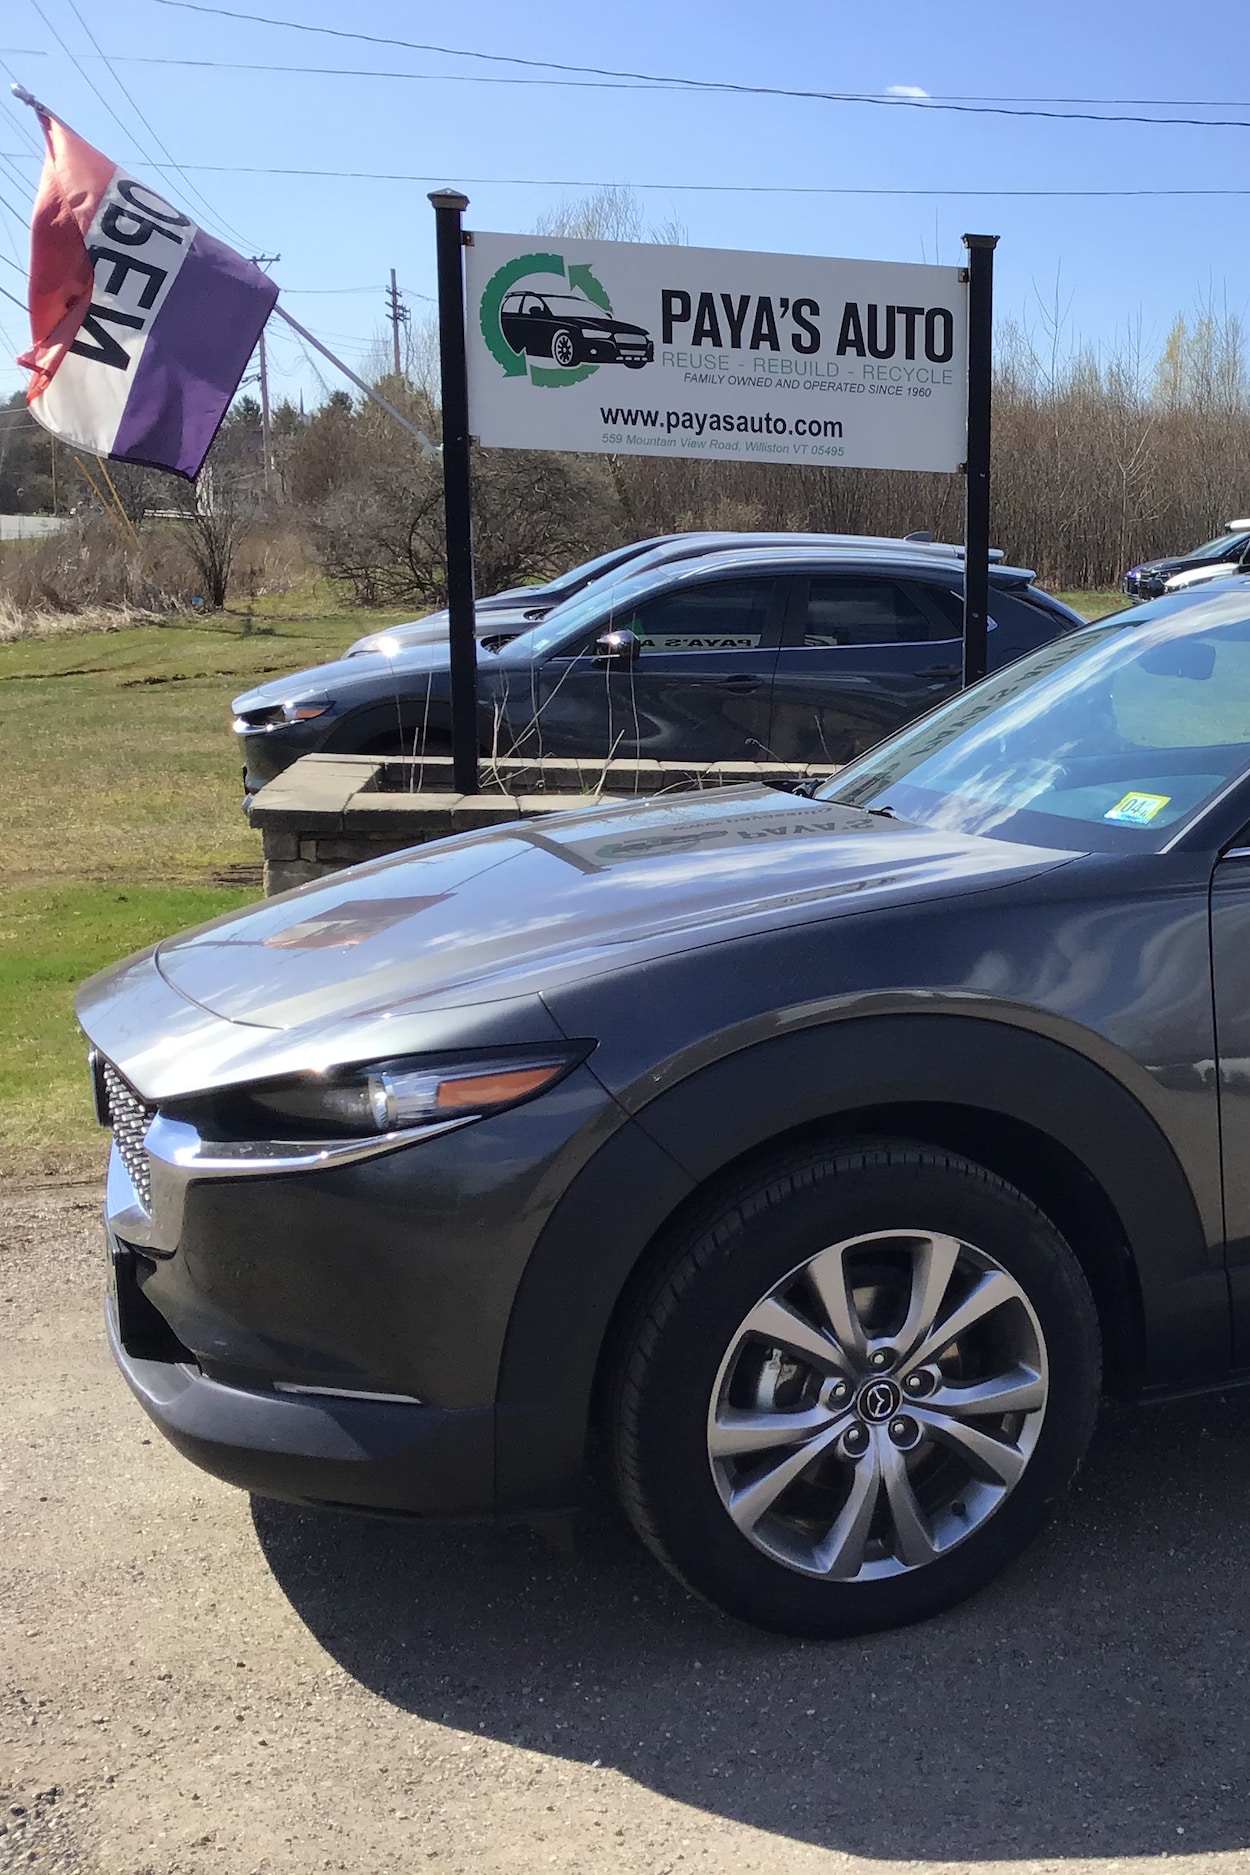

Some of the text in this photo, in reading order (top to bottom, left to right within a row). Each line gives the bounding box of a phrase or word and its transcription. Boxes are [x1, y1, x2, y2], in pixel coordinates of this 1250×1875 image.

[661, 289, 953, 363] PAYA'S AUTO
[662, 351, 730, 371] REUSE
[753, 357, 839, 378] REBUILD
[863, 364, 953, 385] RECYCLE
[683, 372, 932, 398] FAMILY OWNED AND OPERATED SINCE 1960
[600, 407, 843, 438] www.payasauto.com
[601, 433, 845, 457] 559 Mountain View Road, Williston VT 05495
[1120, 798, 1148, 815] 04
